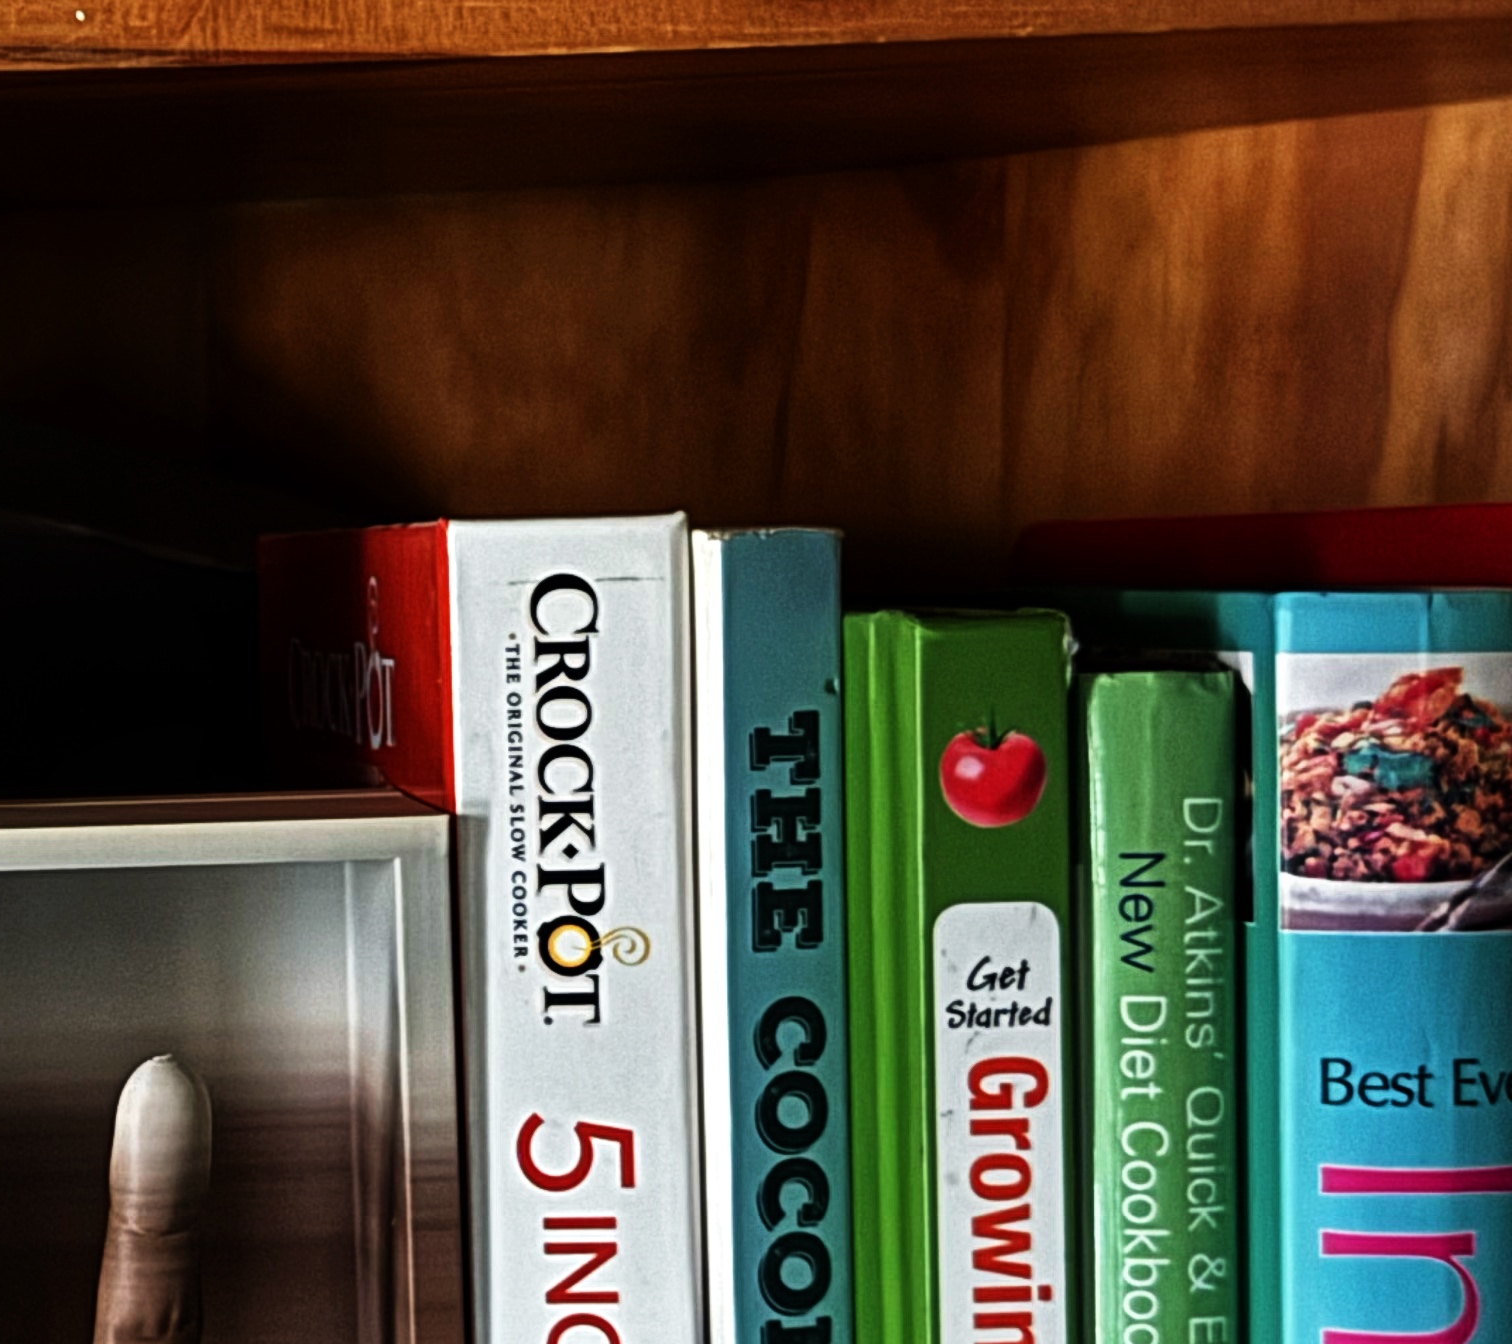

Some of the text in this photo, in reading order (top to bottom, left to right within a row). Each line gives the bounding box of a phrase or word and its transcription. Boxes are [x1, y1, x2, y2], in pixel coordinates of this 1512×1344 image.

[505, 642, 532, 959] THE ORIGINAL SLOW COOKER
[748, 709, 826, 953] THE
[1182, 795, 1224, 865] Dr.
[1119, 851, 1168, 973] New
[945, 996, 1054, 1029] Started
[966, 955, 1031, 992] Get
[1121, 993, 1168, 1100] Diet
[1320, 1056, 1435, 1109] Best
[517, 1111, 638, 1191] 5
[1185, 1085, 1228, 1232] Quick
[1188, 1251, 1225, 1293] &
